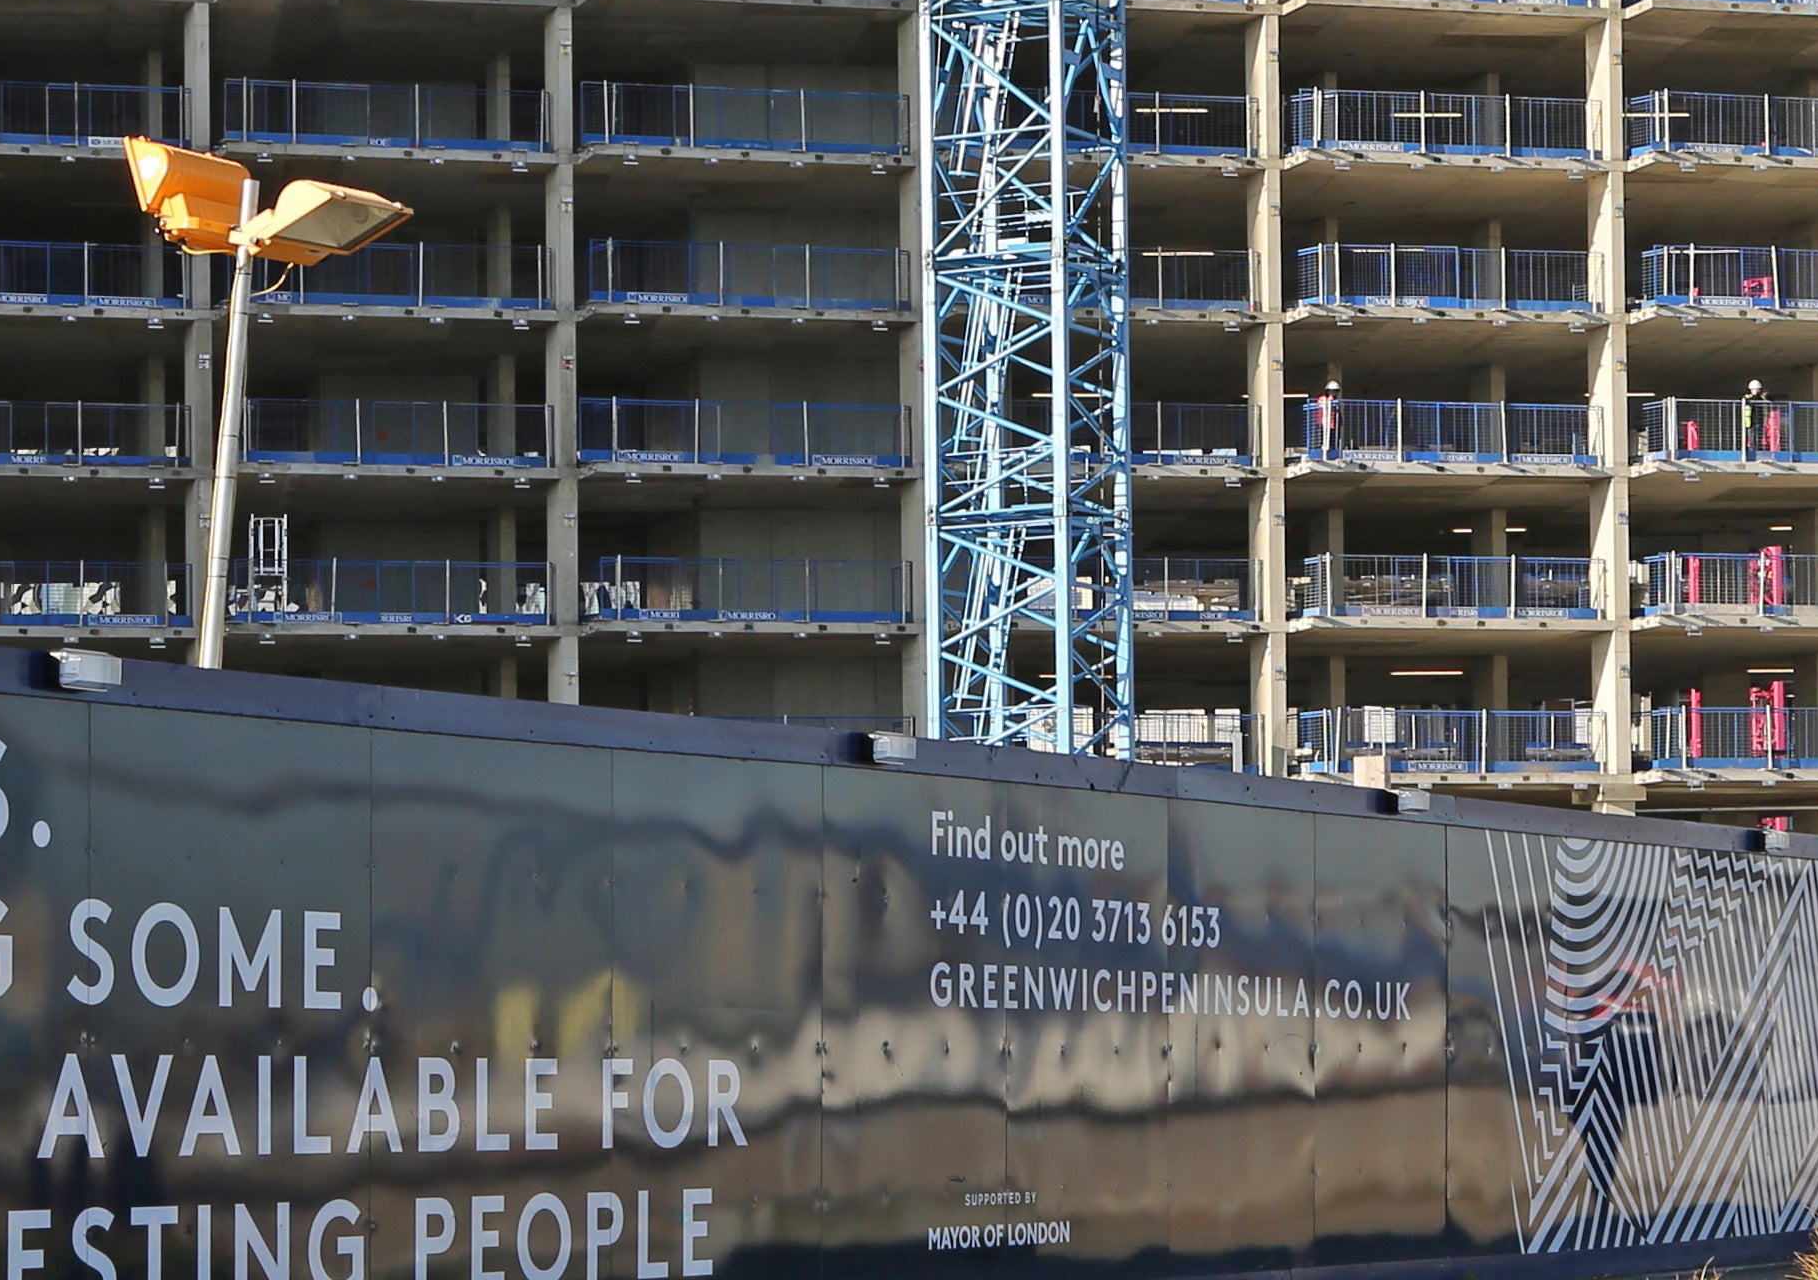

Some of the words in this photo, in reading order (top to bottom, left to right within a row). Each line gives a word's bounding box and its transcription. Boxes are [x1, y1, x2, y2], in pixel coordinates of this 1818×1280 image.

[1348, 141, 1402, 152] MORRISROE
[97, 298, 153, 308] MORRISROE
[1699, 297, 1749, 307] MORRISROE
[462, 456, 518, 467] MORRISROE
[626, 452, 683, 463] MORRISROE
[1182, 455, 1237, 465] MORRISROE
[99, 615, 154, 626] MORRISROE
[931, 811, 991, 860] Find
[1000, 826, 1049, 865] out
[1058, 834, 1125, 871] more
[930, 889, 989, 935] +44
[1001, 892, 1081, 949] (0)20
[1091, 899, 1151, 944] 3713
[1161, 904, 1221, 948] 6153
[67, 899, 378, 1013] SOME.
[929, 961, 1412, 1021] GREENWICHPENINSULA.CO.UK
[36, 1053, 560, 1160] AVAILABLE
[602, 1057, 749, 1149] FOR
[964, 1192, 1021, 1206] SUPPORTED
[1025, 1191, 1037, 1204] BY
[414, 1188, 714, 1280] PEOPLE
[928, 1225, 981, 1251] MAYOR
[984, 1223, 1004, 1247] OF
[1008, 1220, 1070, 1246] LONDON
